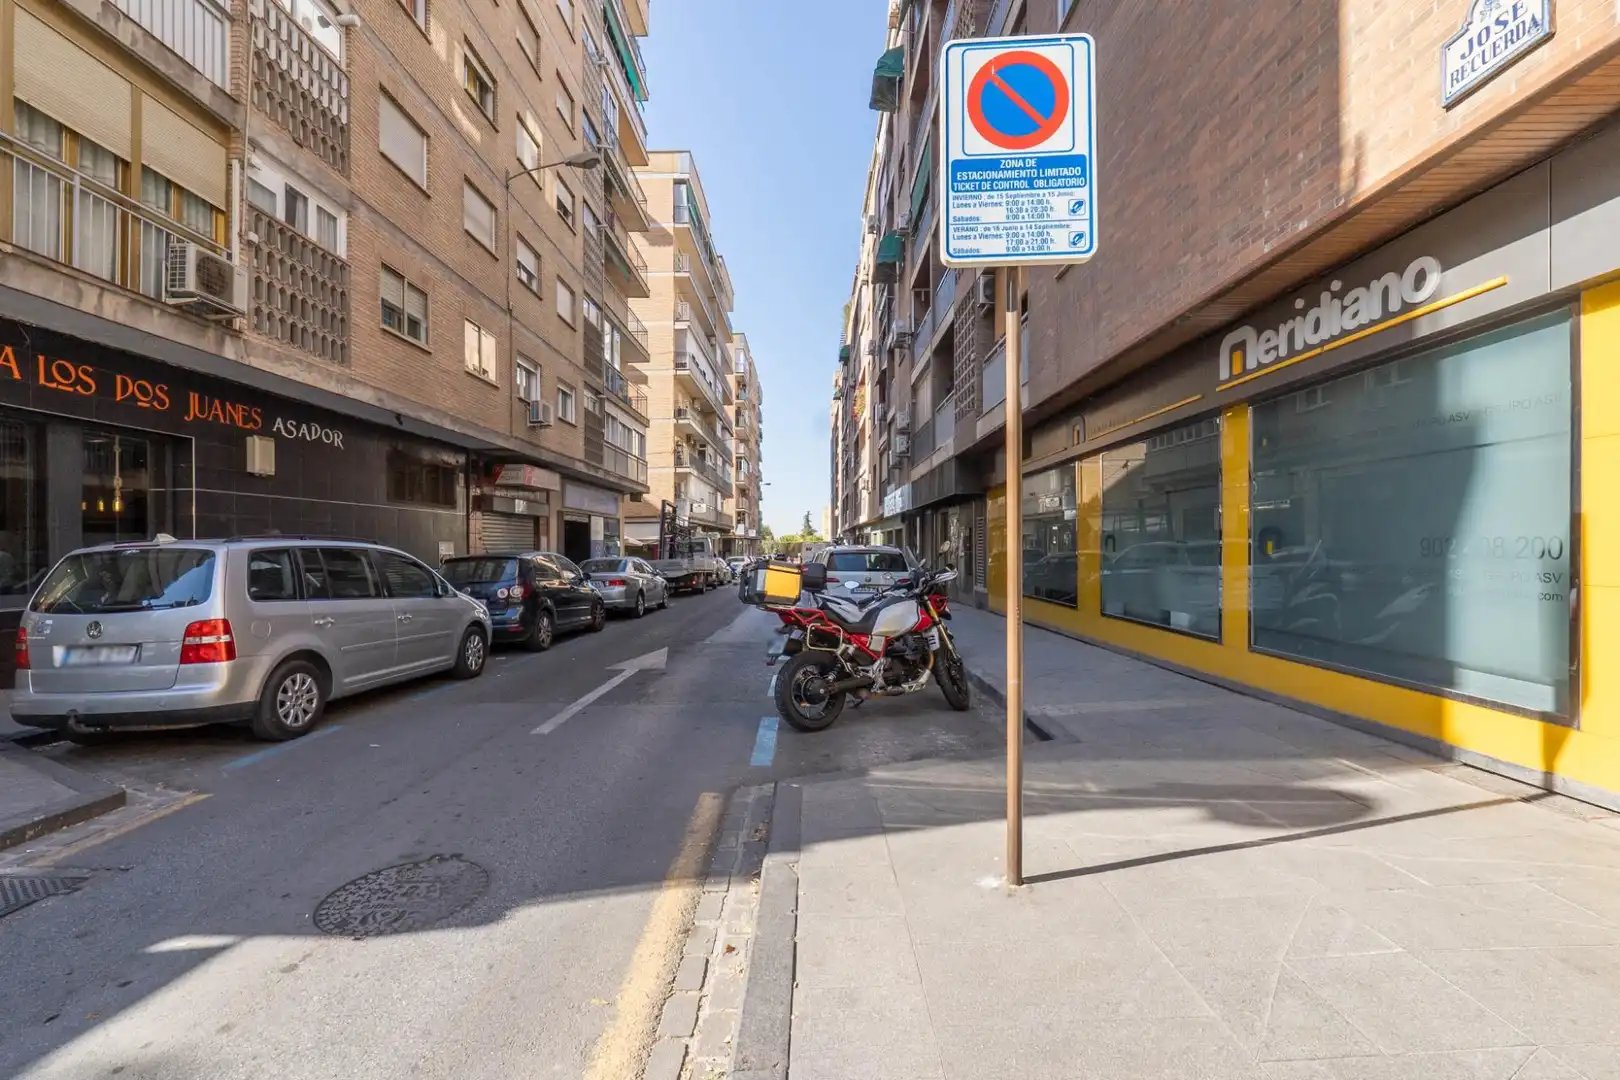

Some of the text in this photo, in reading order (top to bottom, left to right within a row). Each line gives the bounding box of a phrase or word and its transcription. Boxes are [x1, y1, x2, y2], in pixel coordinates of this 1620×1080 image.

[1459, 1, 1529, 61] JOSE
[1449, 13, 1542, 89] RECUERDA
[956, 167, 1081, 181] ESTACIONAMIENTO LIMITADO
[1000, 158, 1037, 168] ZONA DE
[953, 177, 1085, 192] TICKET DE CONTROL OBLIGATORIO
[1004, 192, 1040, 200] Septiembre
[1219, 255, 1443, 381] Meridiano
[36, 354, 97, 396] LOS
[115, 374, 171, 411] DOS
[184, 391, 262, 431] JUANES
[272, 417, 345, 451] ASADOR
[1515, 534, 1564, 561] 200
